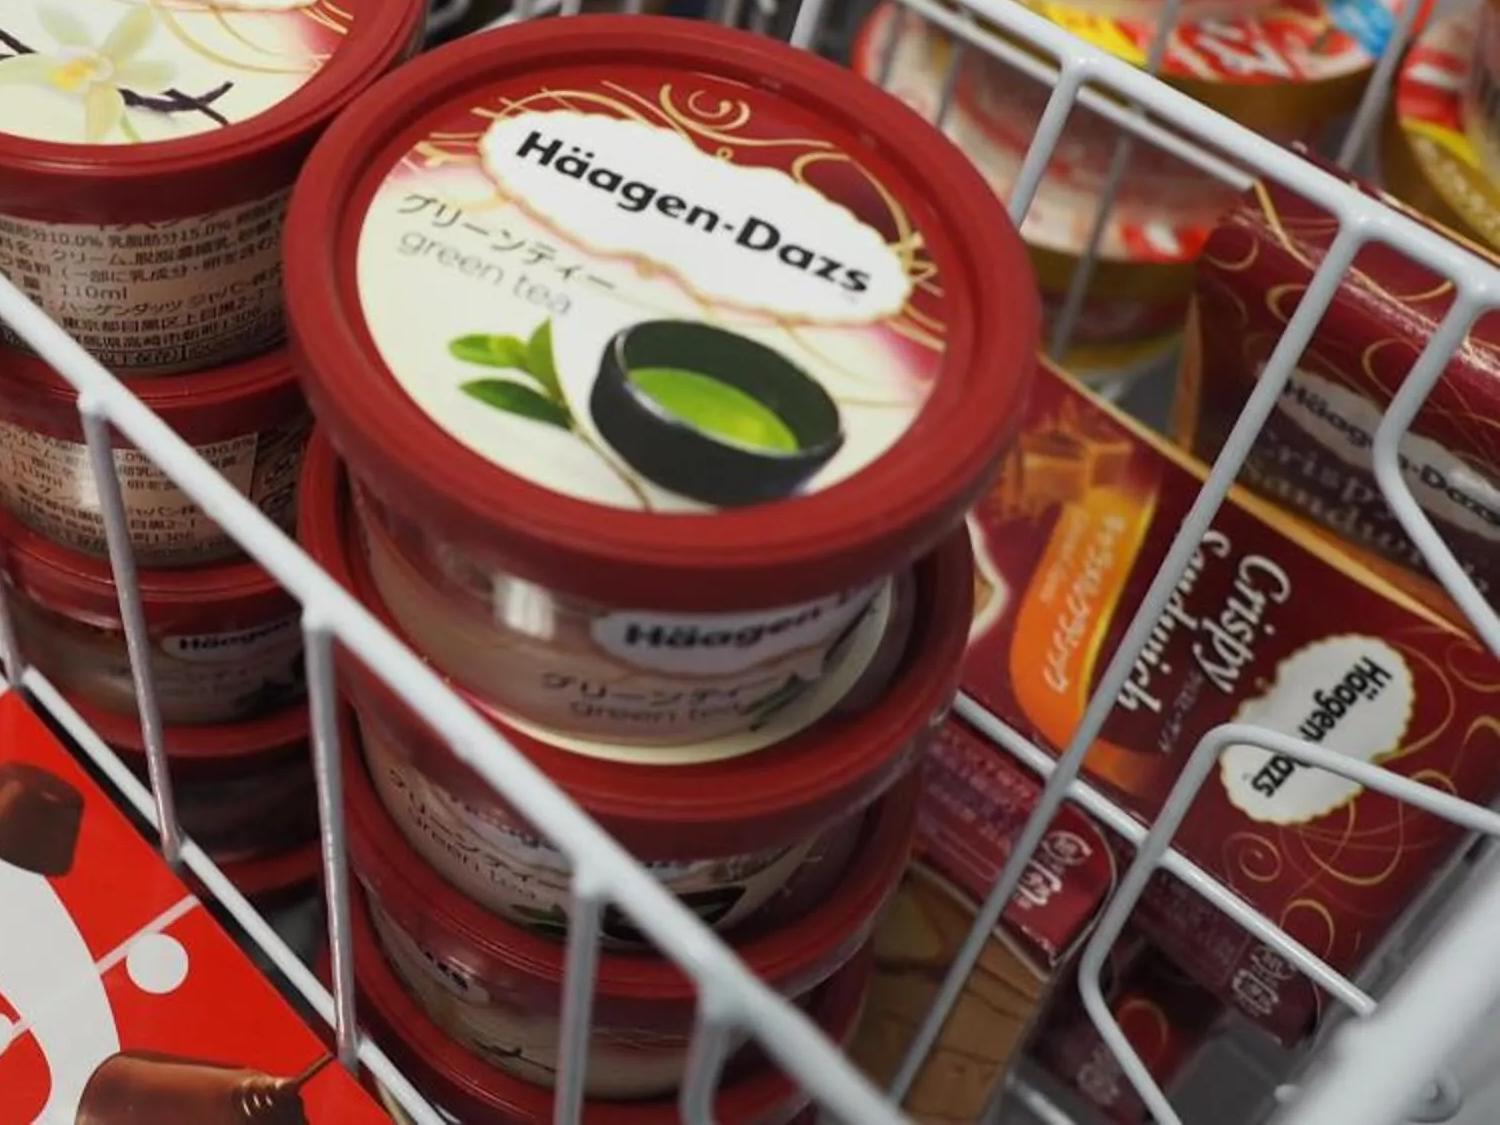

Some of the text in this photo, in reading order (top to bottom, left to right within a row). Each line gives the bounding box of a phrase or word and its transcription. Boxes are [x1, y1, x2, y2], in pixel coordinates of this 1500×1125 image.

[395, 188, 618, 293] グリーンティー
[397, 228, 574, 318] green tea
[514, 129, 875, 297] Häagen-Dazs
[1198, 553, 1291, 694] Crispy
